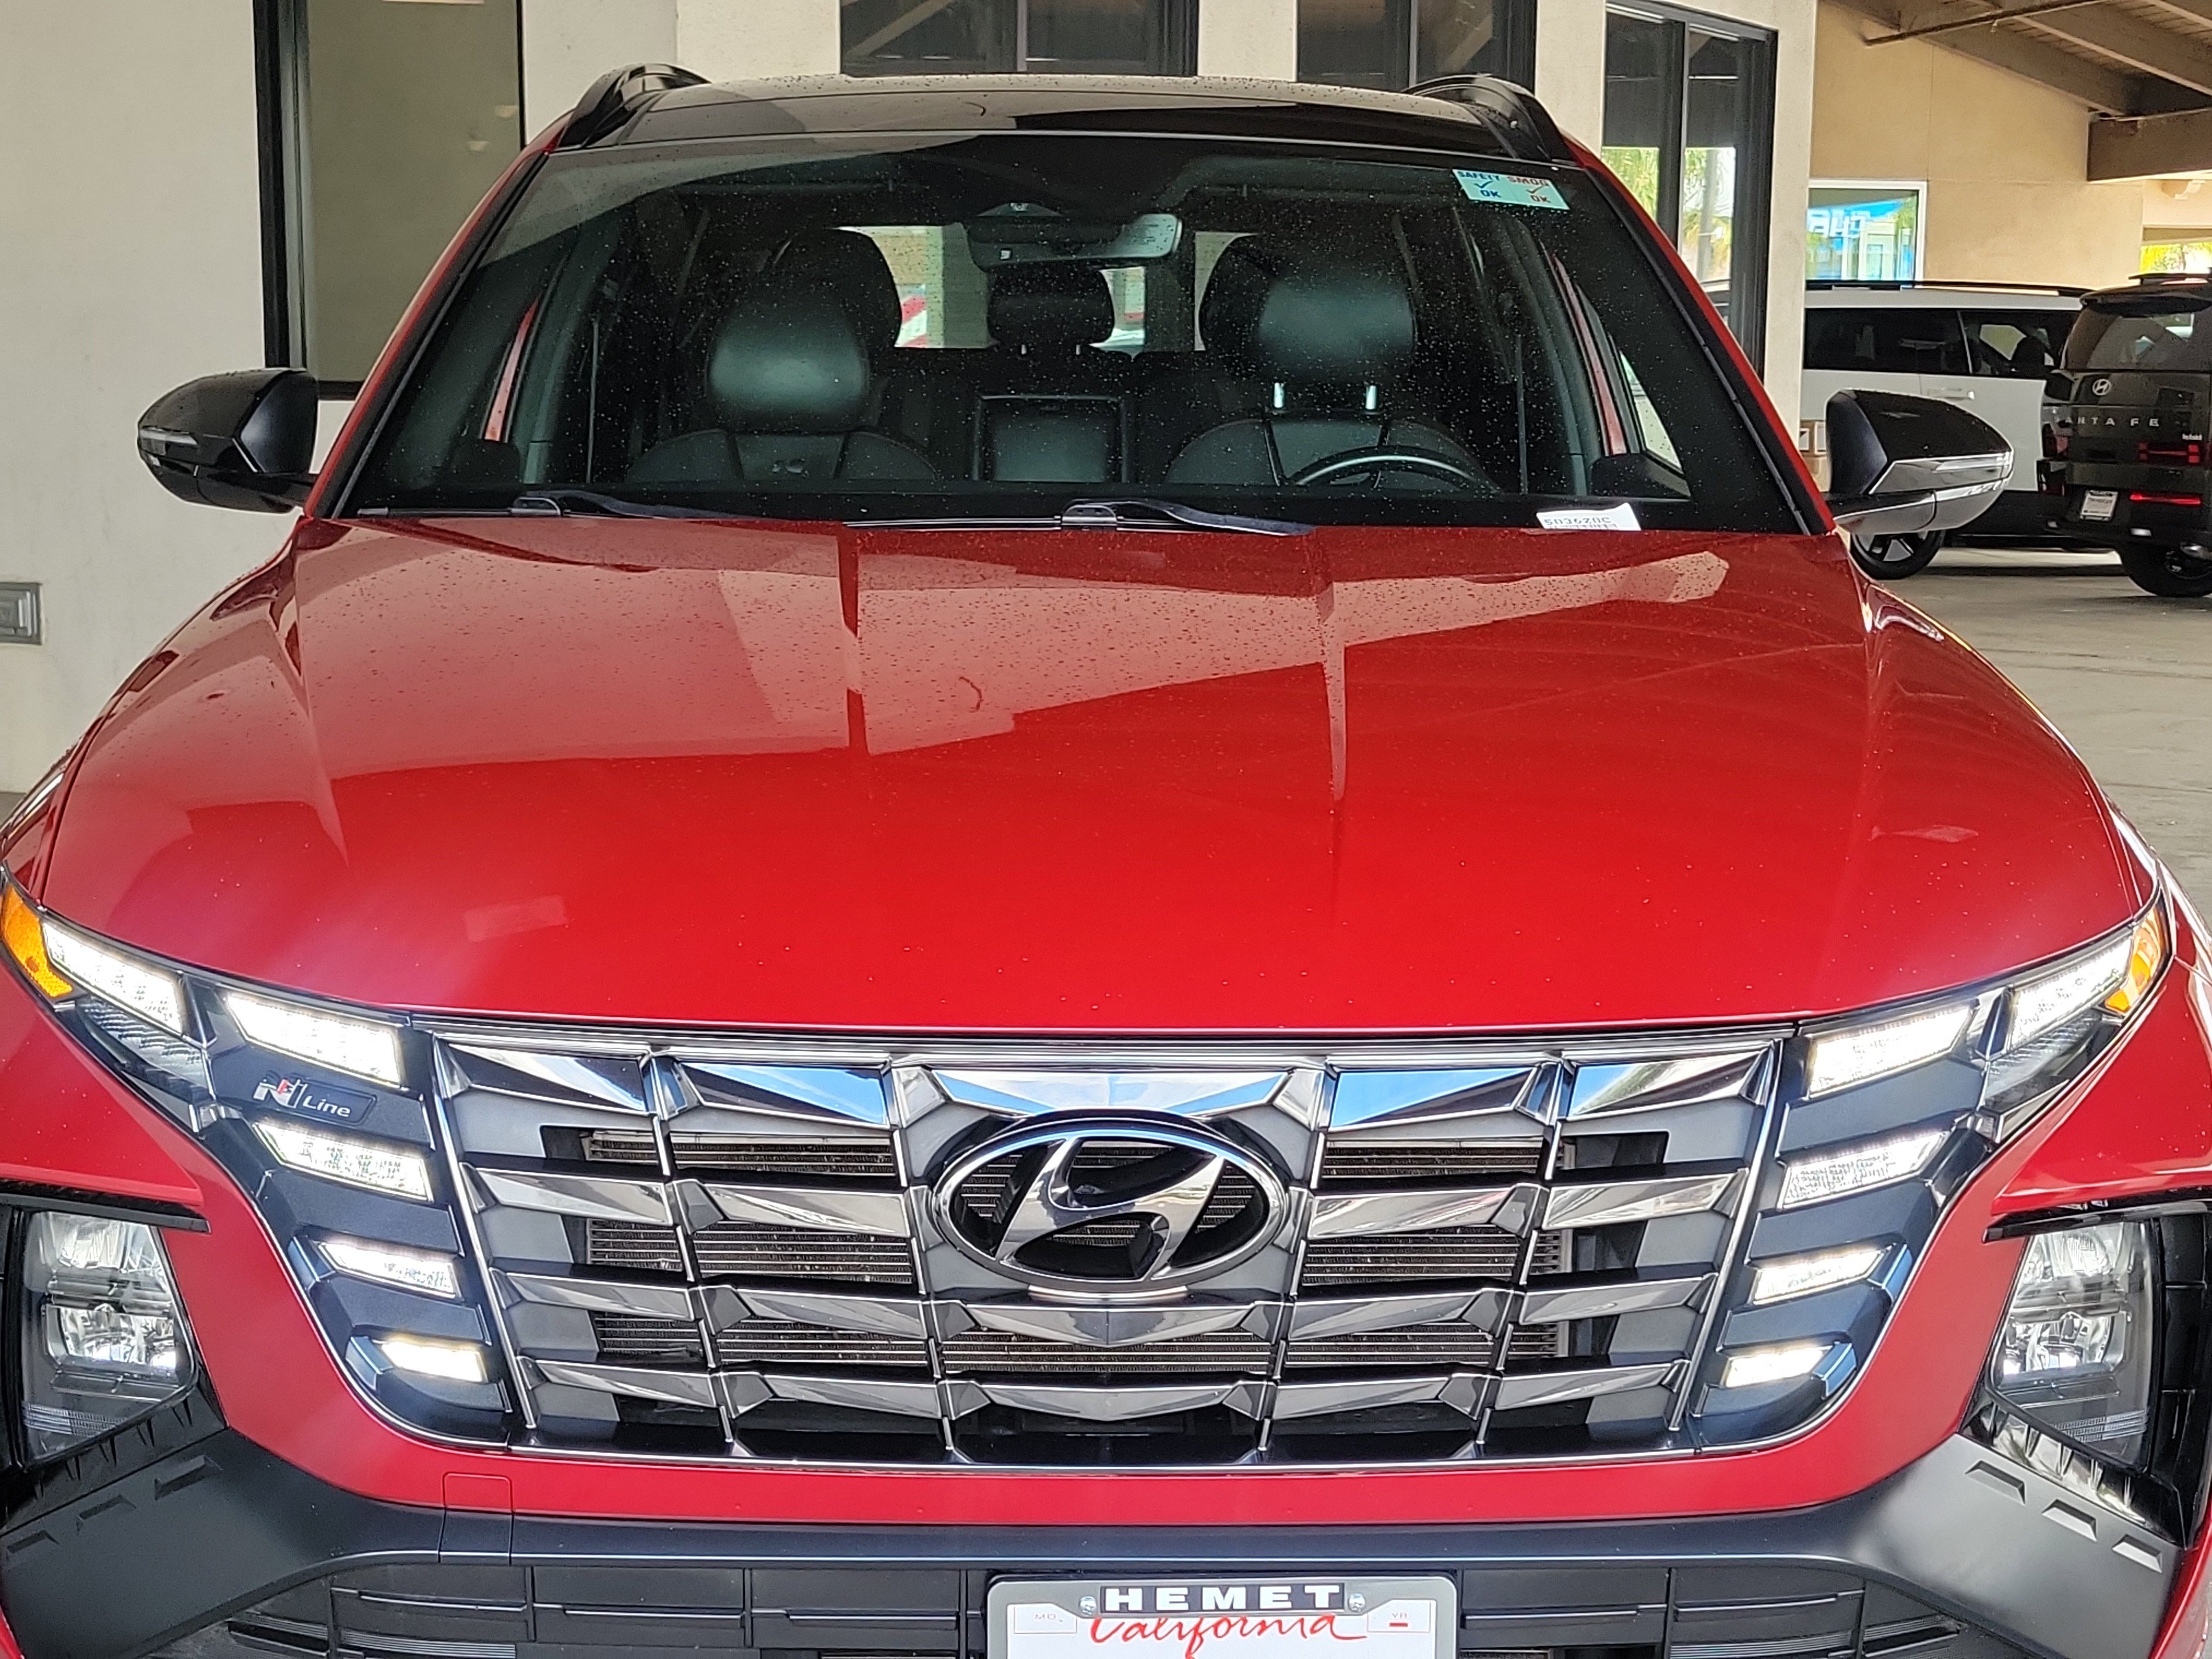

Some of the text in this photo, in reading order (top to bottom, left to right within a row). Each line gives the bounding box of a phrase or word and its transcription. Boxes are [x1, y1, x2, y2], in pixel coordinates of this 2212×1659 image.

[1457, 171, 1500, 182] SAFETY
[1506, 176, 1549, 187] SMOG
[1480, 189, 1502, 199] OK
[1530, 195, 1551, 204] OK
[2130, 417, 2160, 427] FE
[303, 1096, 351, 1117] Line
[1105, 1584, 1340, 1611] HEMET
[1090, 1615, 1367, 1659] California
